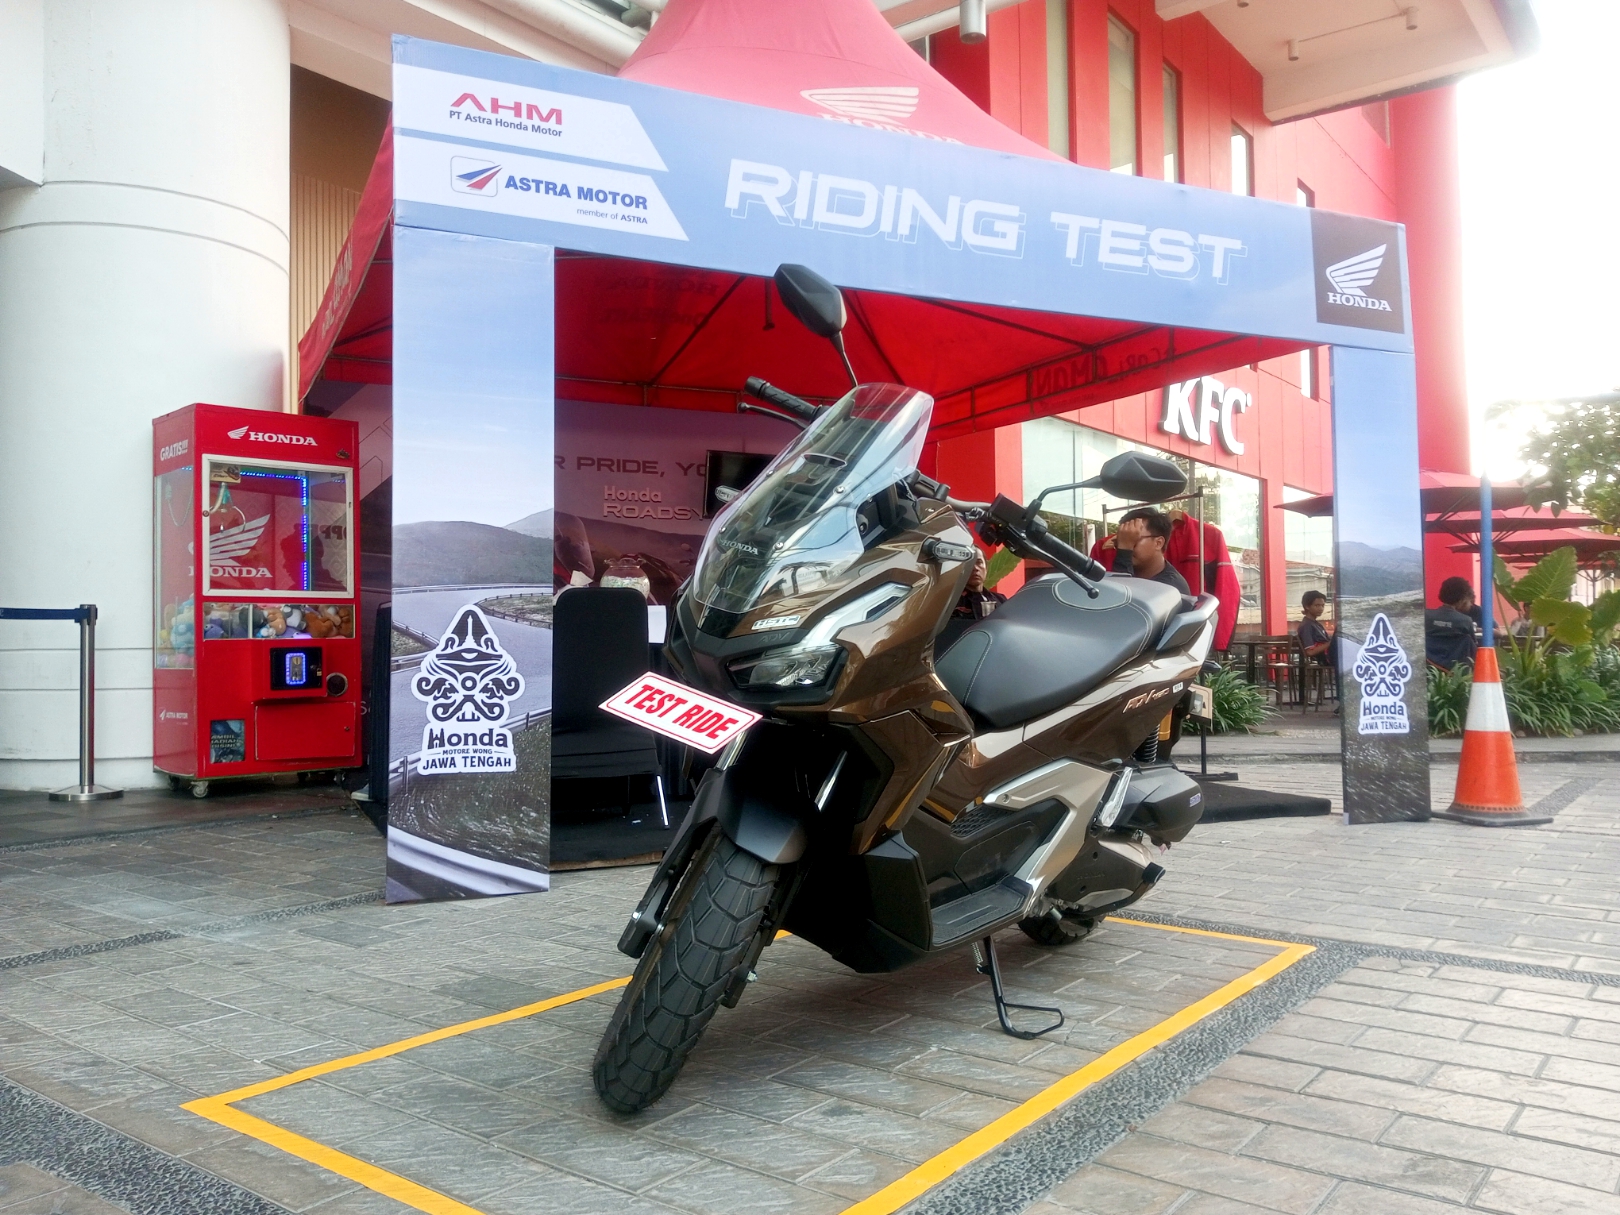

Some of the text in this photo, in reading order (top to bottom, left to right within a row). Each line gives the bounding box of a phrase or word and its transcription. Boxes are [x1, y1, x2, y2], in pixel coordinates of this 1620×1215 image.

[450, 92, 563, 125] AHM
[449, 110, 563, 137] PT Astra Honda Motor
[505, 175, 648, 210] ASTRA MOTOR
[576, 208, 648, 224] member of ASTRA
[724, 158, 1247, 284] RIDING TEST
[1327, 291, 1393, 312] HONDA
[1161, 376, 1246, 456] KFC
[248, 431, 318, 447] HONDA
[576, 456, 665, 478] PRIDE,
[604, 485, 662, 503] Honda
[721, 538, 759, 556] HONDA
[624, 683, 739, 740] TEST RIDE
[1363, 701, 1405, 716] Honda
[1361, 721, 1407, 731] JAWA TENGAH
[427, 728, 509, 750] Honda
[422, 755, 512, 770] JAWA TENGAH
[442, 748, 469, 756] MOTORE
